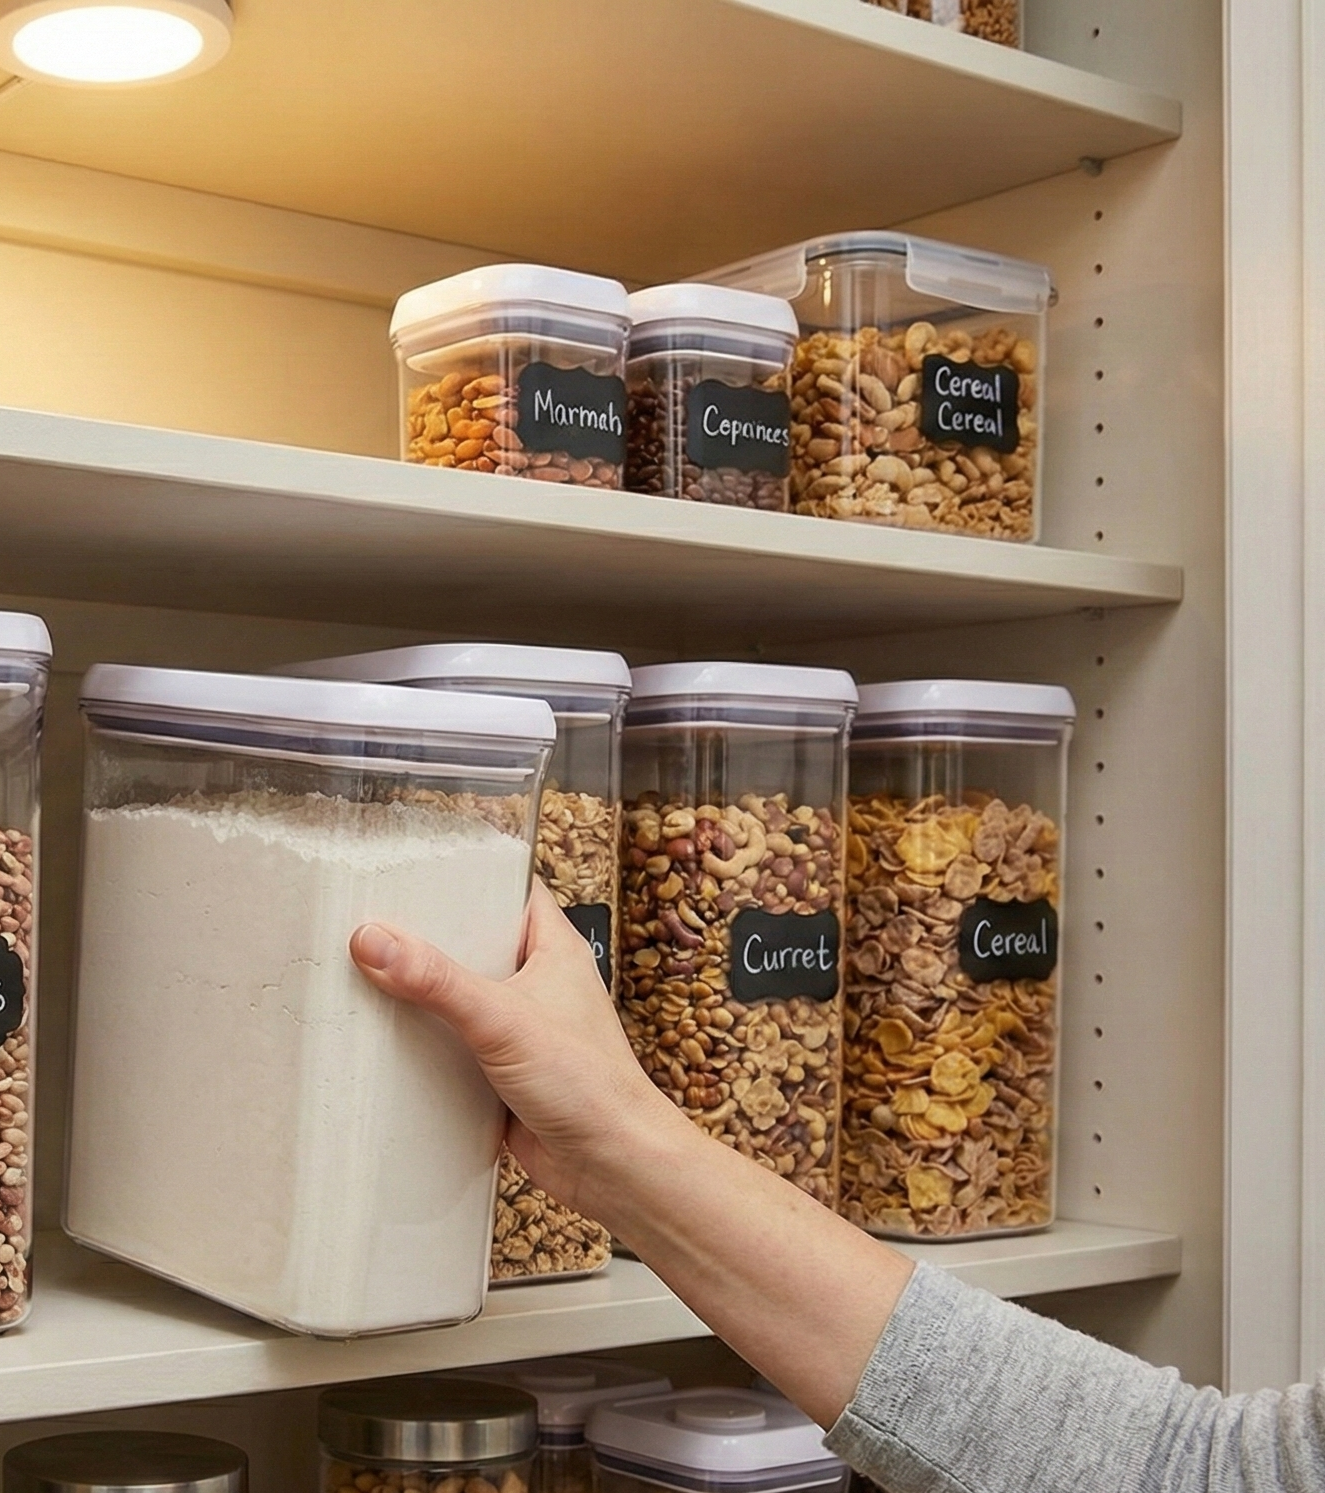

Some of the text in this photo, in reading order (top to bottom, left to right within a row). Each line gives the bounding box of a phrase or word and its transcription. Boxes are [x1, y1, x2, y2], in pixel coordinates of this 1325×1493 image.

[935, 366, 1001, 403] Cereal
[938, 401, 1003, 437] Cereal
[743, 933, 833, 974] Curret
[973, 917, 1047, 958] Cereal
